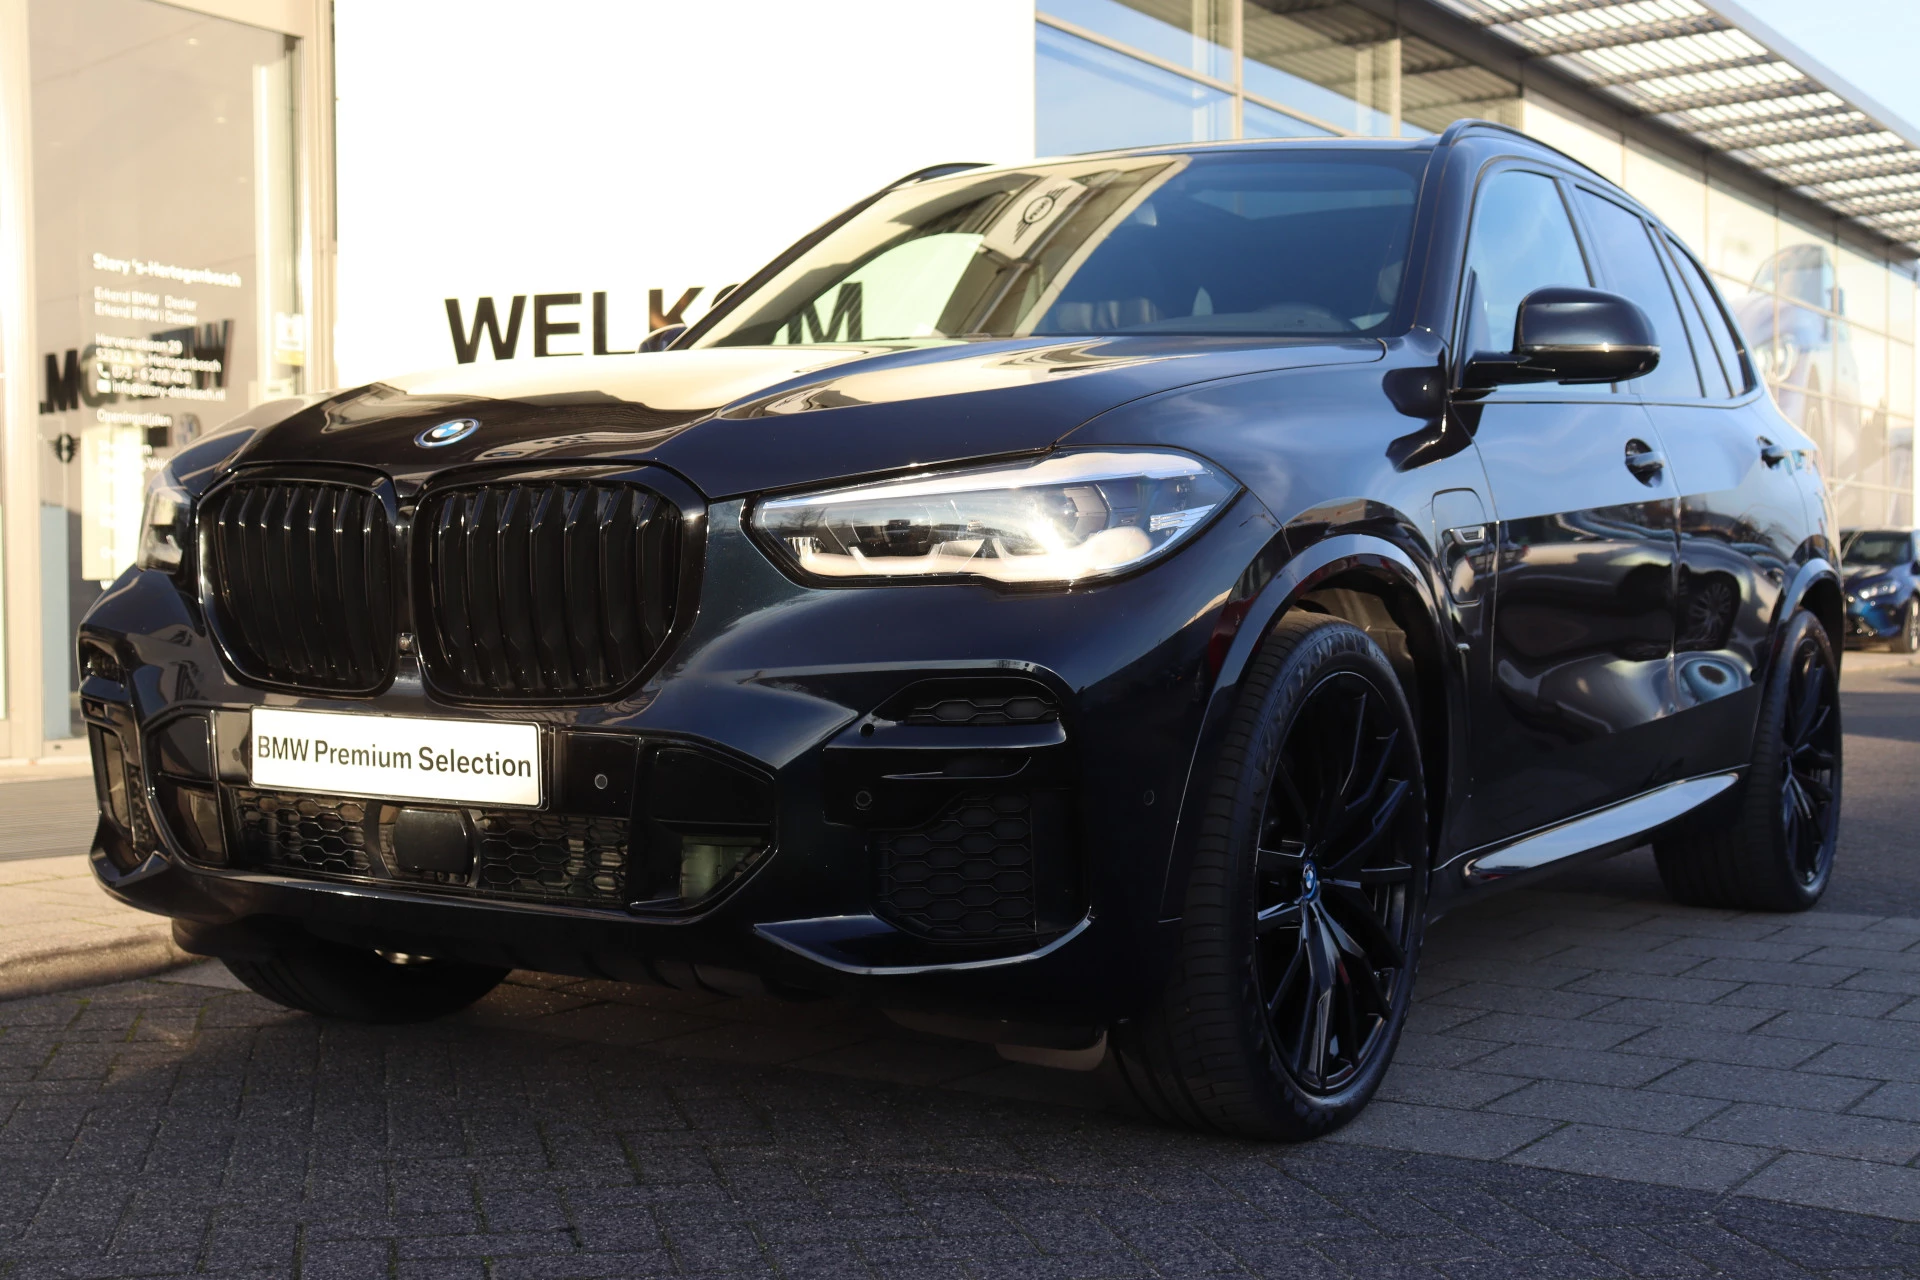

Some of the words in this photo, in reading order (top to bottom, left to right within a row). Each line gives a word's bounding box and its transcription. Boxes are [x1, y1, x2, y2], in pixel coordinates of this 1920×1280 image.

[93, 252, 130, 275] Story
[131, 290, 159, 307] BMW
[164, 294, 197, 312] Dealer
[131, 305, 159, 322] BMW
[164, 309, 197, 326] Dealer
[445, 281, 863, 364] WELKM
[168, 339, 183, 355] 29
[258, 735, 309, 762] BMW
[314, 740, 412, 769] Premium
[418, 746, 532, 778] Selection
